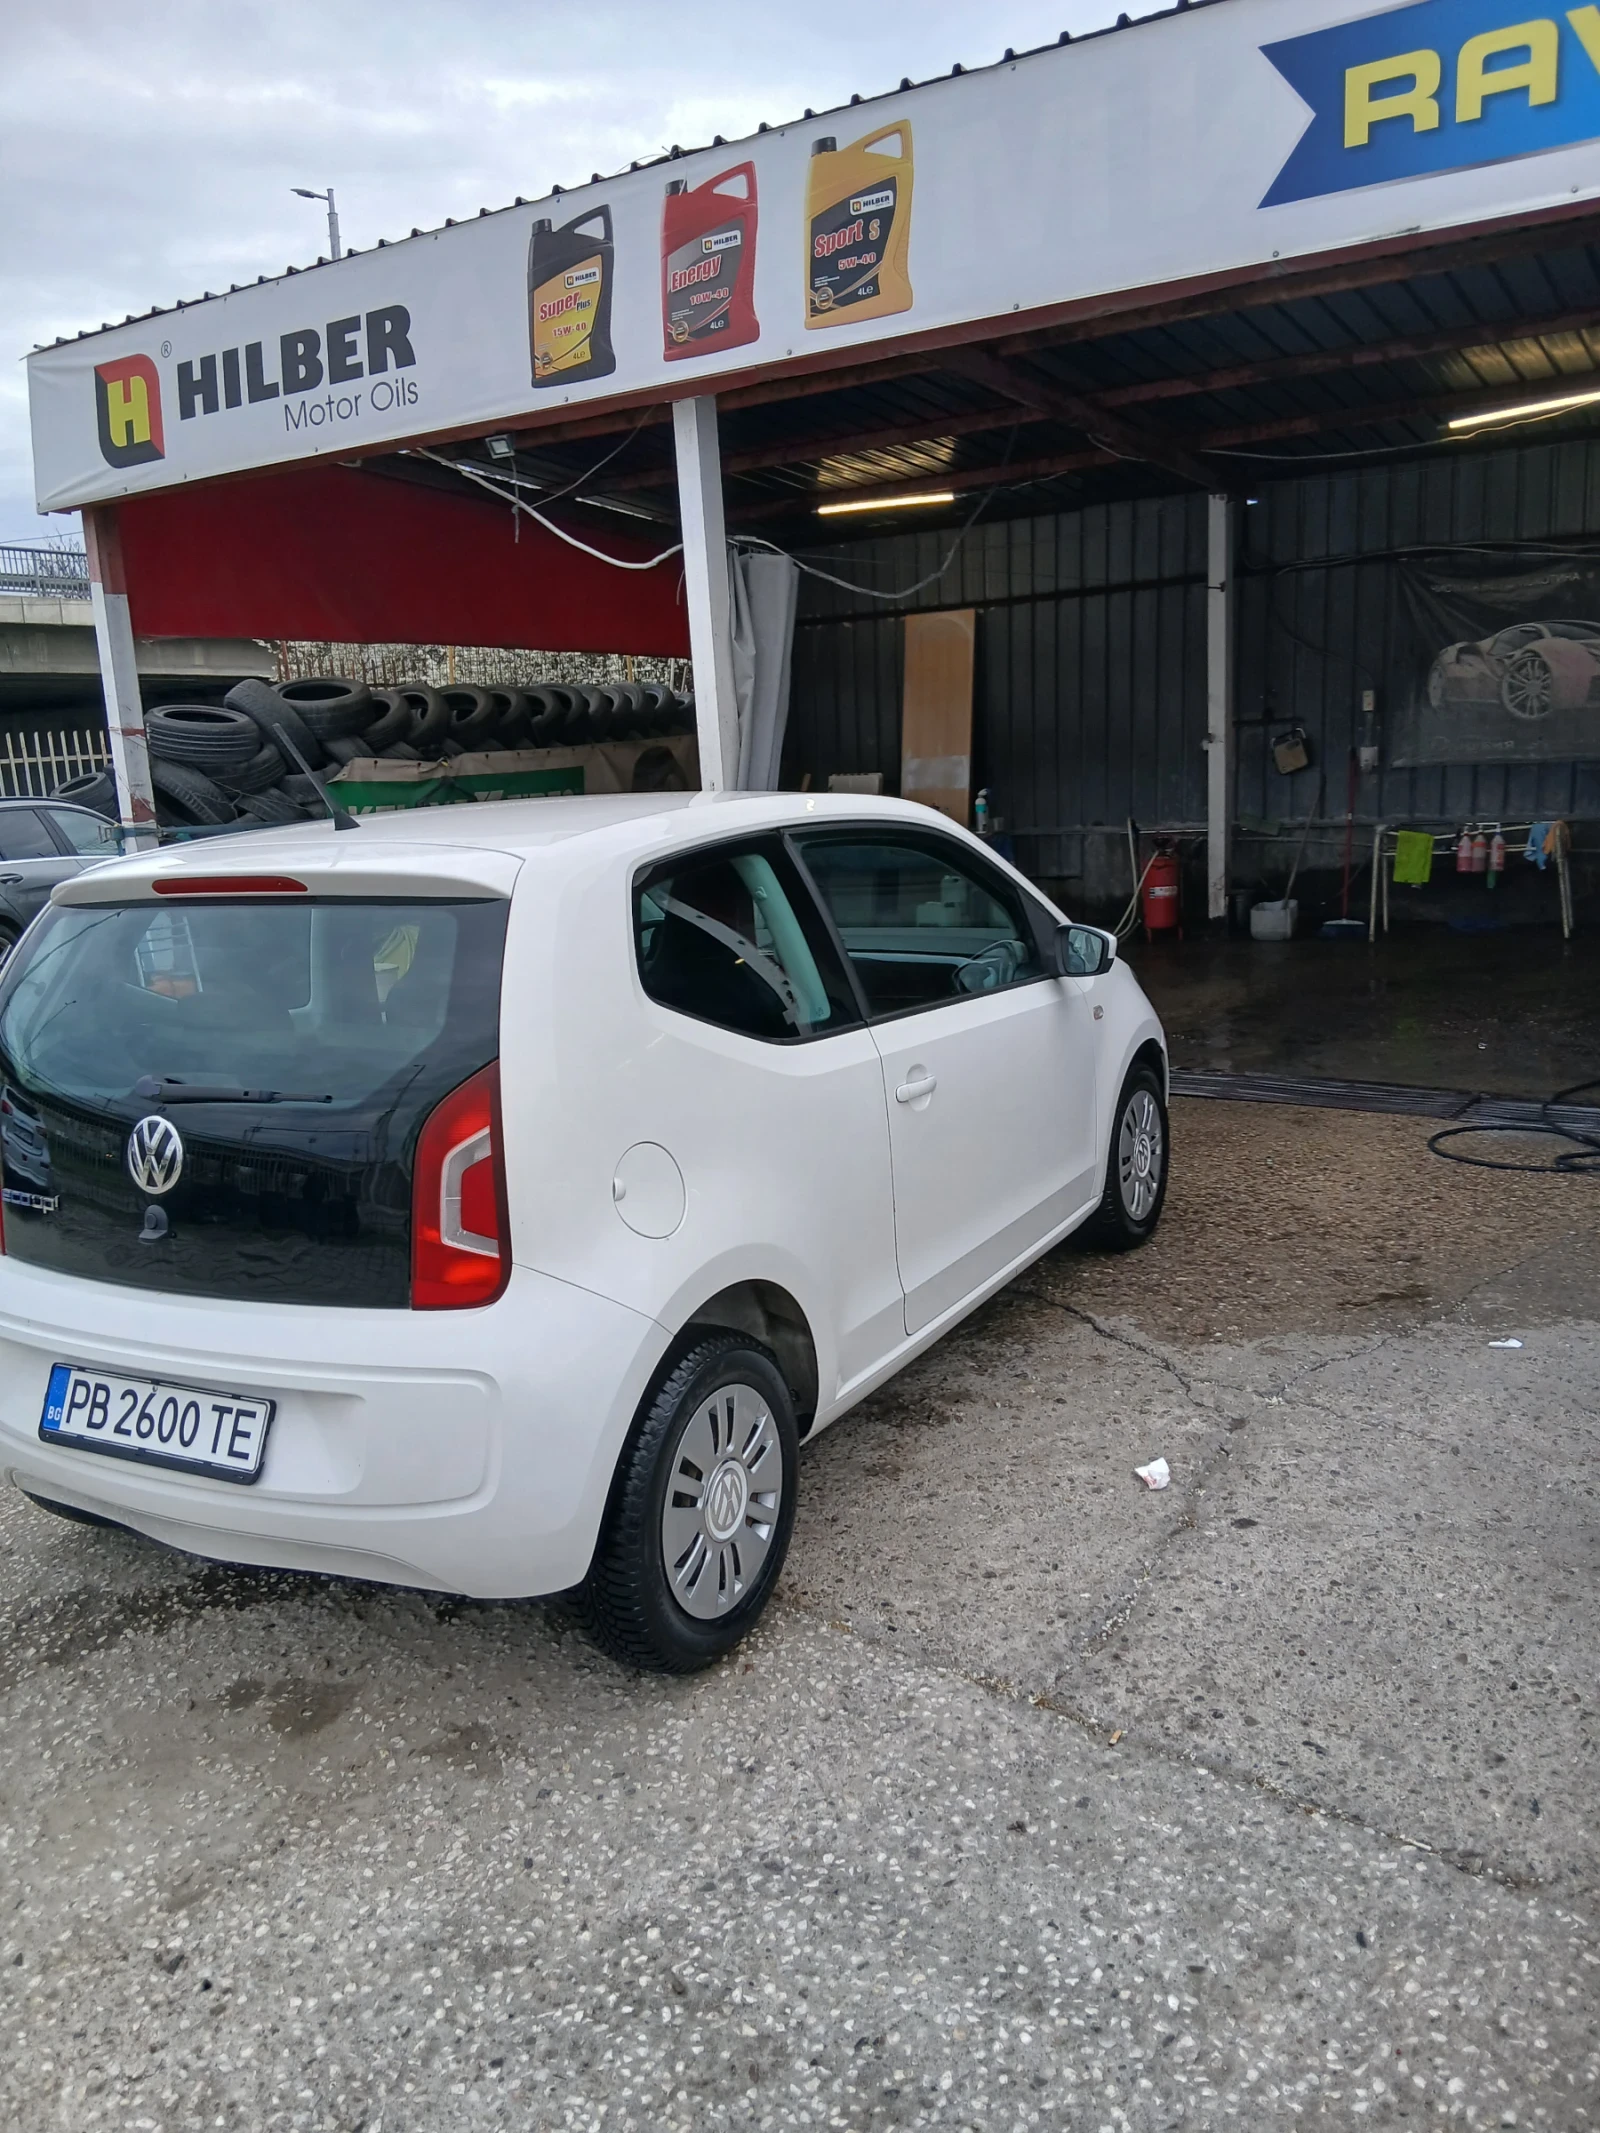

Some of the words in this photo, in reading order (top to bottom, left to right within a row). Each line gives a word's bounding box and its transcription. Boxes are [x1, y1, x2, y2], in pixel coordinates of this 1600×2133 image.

[863, 195, 890, 207] HILBER
[714, 234, 738, 246] HILBER
[814, 219, 863, 258] Sport
[869, 219, 880, 240] S
[838, 252, 876, 270] 5W-40
[575, 271, 596, 282] HILBER
[671, 254, 721, 293] Energy
[540, 291, 580, 321] Super
[577, 299, 591, 312] Plus
[690, 287, 729, 305] 10W-40
[553, 322, 587, 337] 15W-40
[177, 305, 416, 421] HILBER
[284, 393, 361, 431] Motor
[370, 377, 419, 411] Oils
[47, 1406, 61, 1421] BG
[65, 1379, 111, 1430] PB
[113, 1389, 200, 1448] 2600
[211, 1404, 257, 1460] TE
